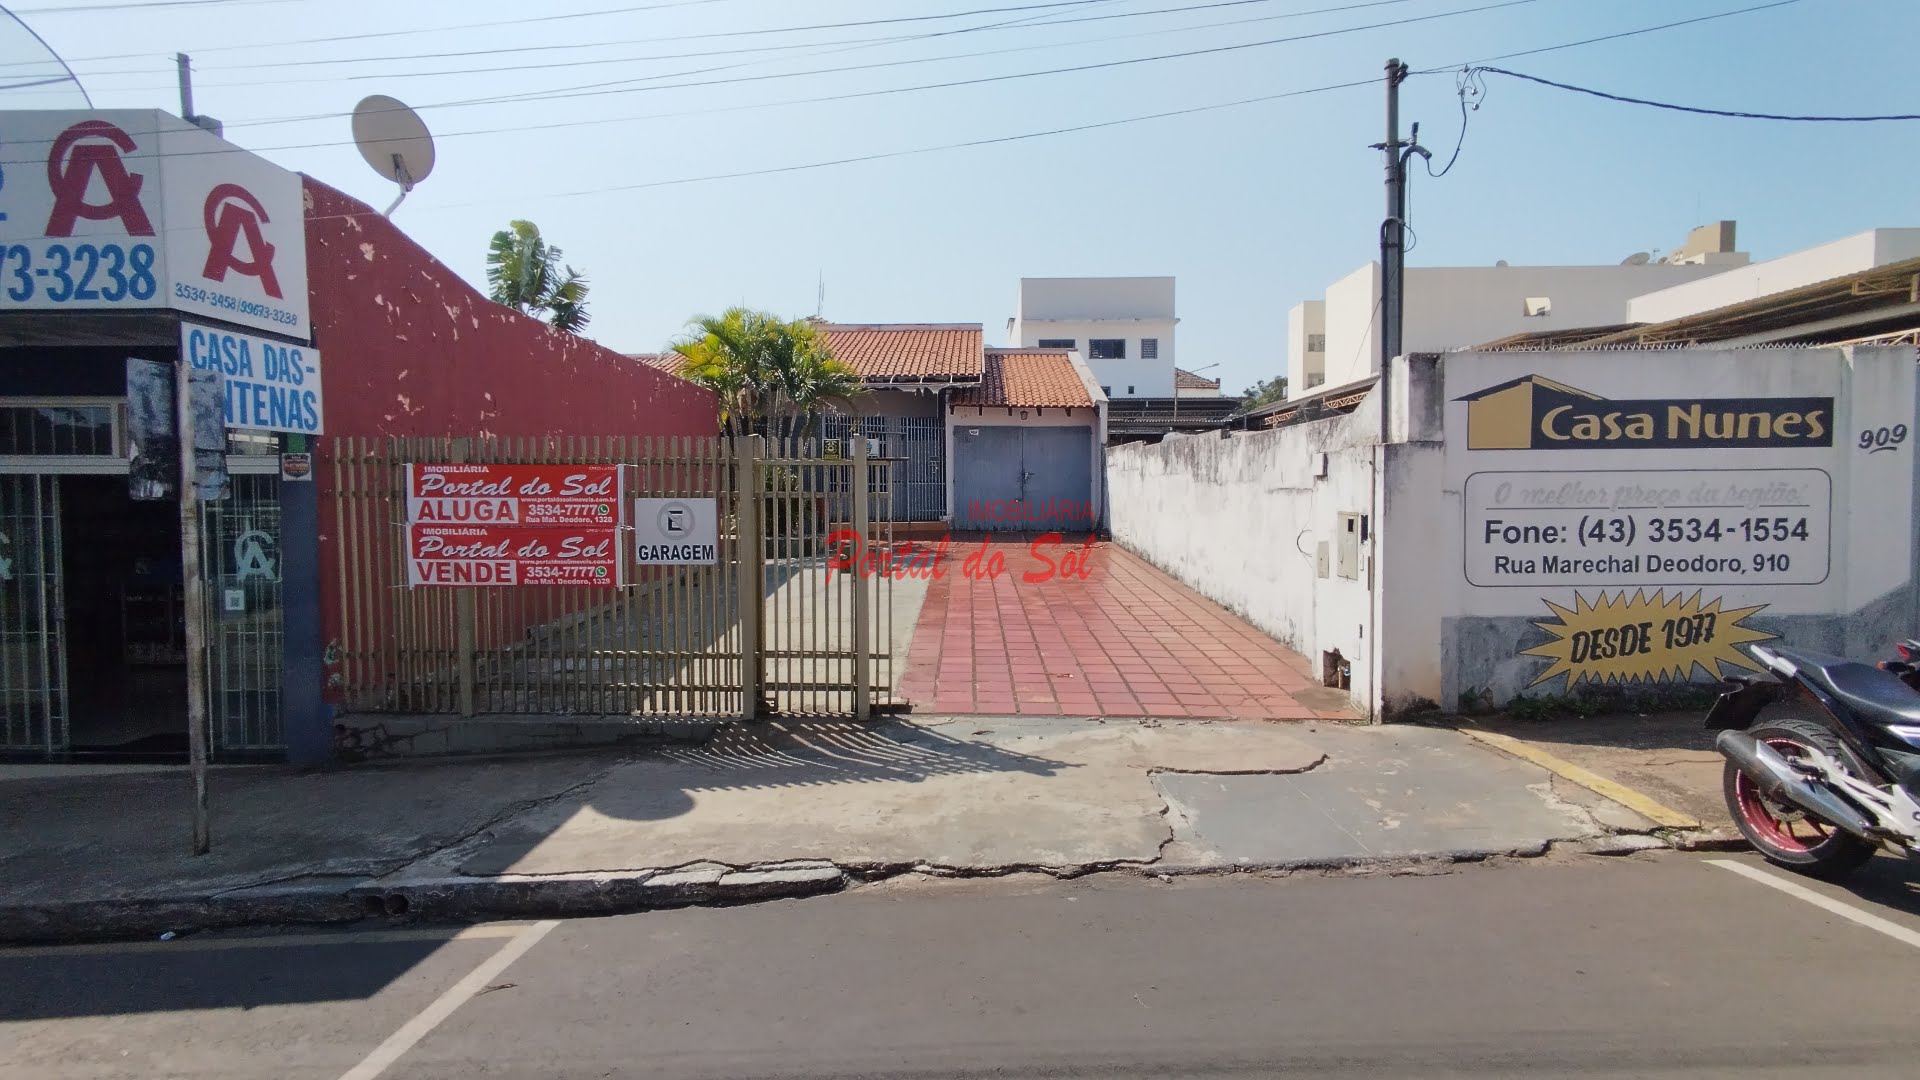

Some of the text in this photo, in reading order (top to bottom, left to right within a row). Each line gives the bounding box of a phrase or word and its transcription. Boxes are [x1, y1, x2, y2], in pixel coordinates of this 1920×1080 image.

[0, 244, 157, 302] 3-3238
[190, 329, 253, 378] CASA
[1541, 404, 1824, 441] Casa Nunes
[1858, 423, 1908, 449] 909
[424, 465, 489, 473] IMOBILIÁRIA
[420, 473, 612, 496] Portal do Sol
[1520, 480, 1609, 505] melhor
[1611, 484, 1681, 512] preço
[1686, 481, 1721, 504] da
[418, 500, 515, 521] ALUGA
[528, 504, 597, 516] 3534-7777
[559, 516, 593, 524] Deodoro,
[423, 527, 488, 536] IMOBILIÁRIA
[1485, 515, 1809, 547] Fone: (43) 3534-1554
[418, 535, 609, 558] Portal do Sol
[638, 544, 715, 561] GARAGEM
[416, 561, 512, 583] VENDE
[526, 566, 595, 578] 3534-7777
[1495, 553, 1790, 575] Rua Marechal Deodoro, 910
[557, 578, 591, 586] Deodoro,
[1570, 612, 1717, 664] DESDE 1977
